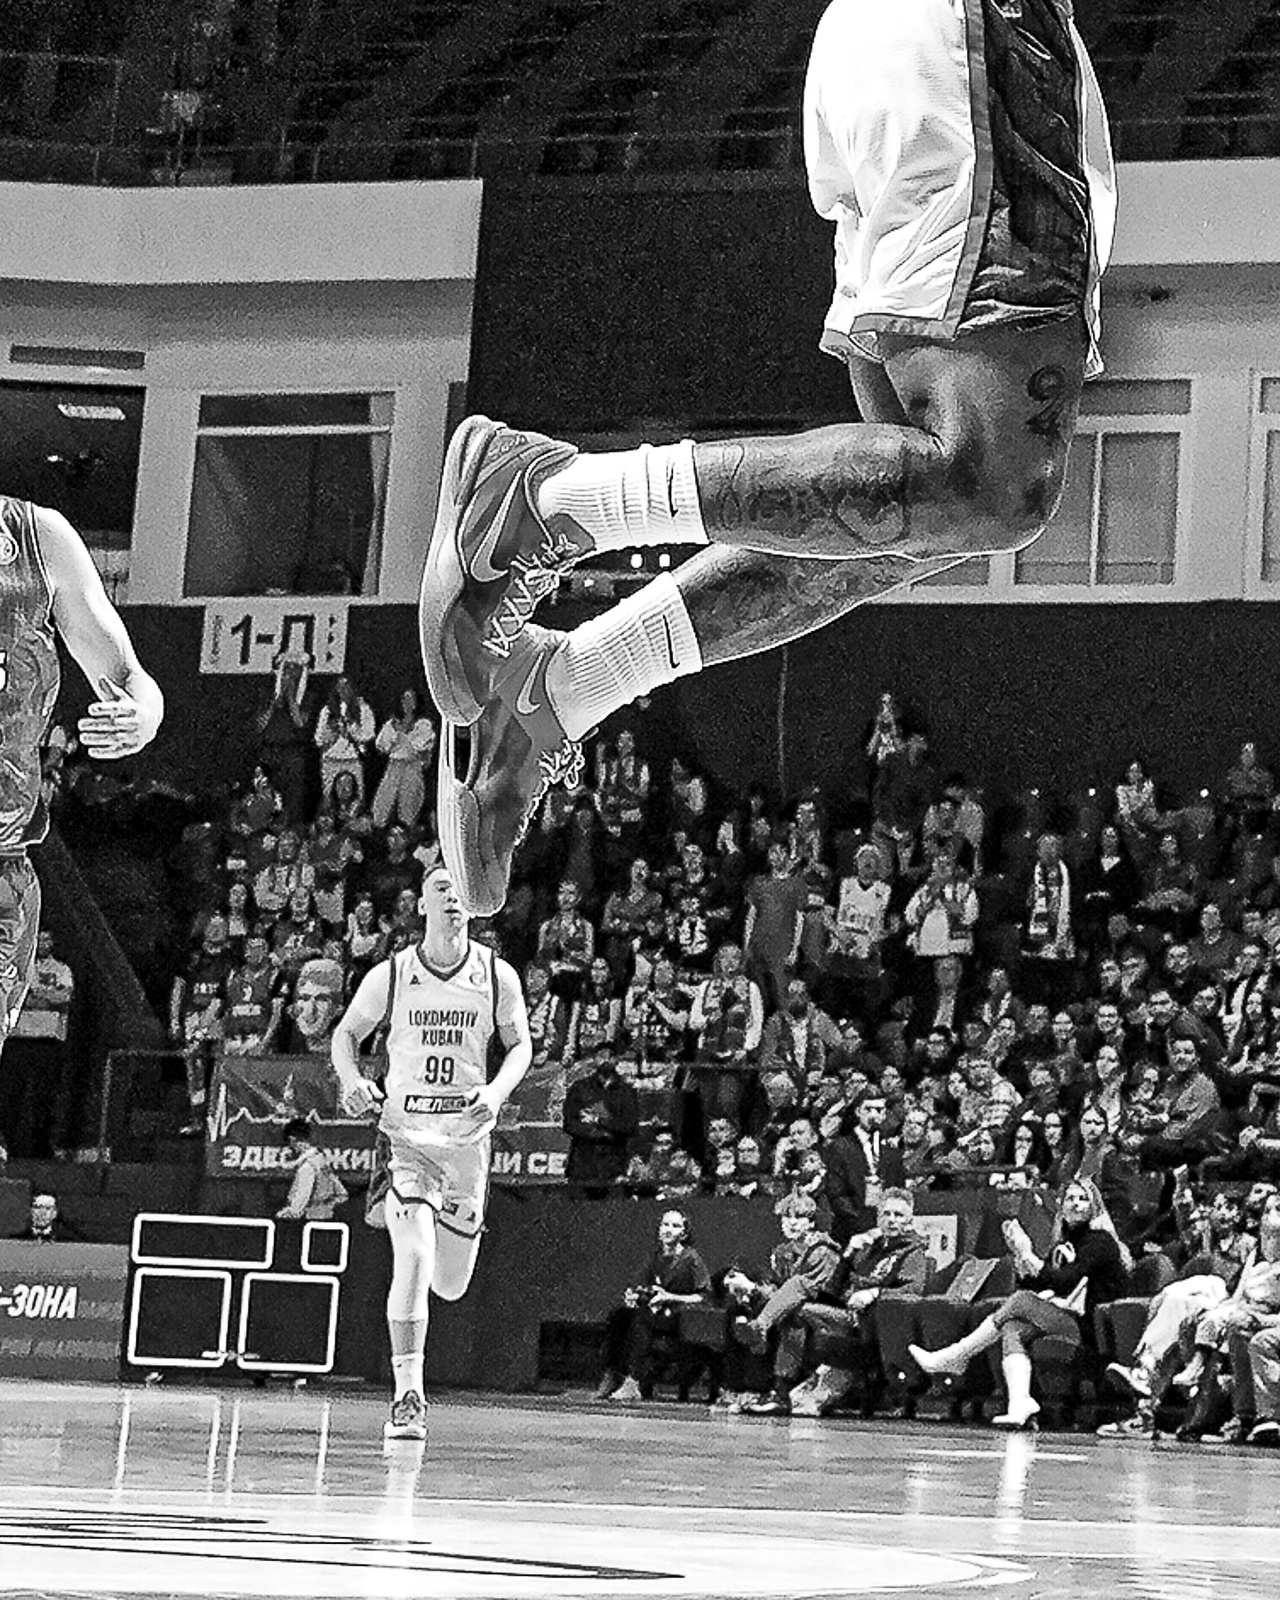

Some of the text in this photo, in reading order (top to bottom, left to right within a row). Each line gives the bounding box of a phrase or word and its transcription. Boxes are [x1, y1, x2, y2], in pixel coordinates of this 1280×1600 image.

[408, 1010, 479, 1028] LOKOMOTIV
[421, 1028, 464, 1046] KUBAN
[424, 1055, 455, 1086] 99
[222, 1145, 294, 1171] ЗДЕС
[0, 1283, 77, 1319] -ЗОНА
